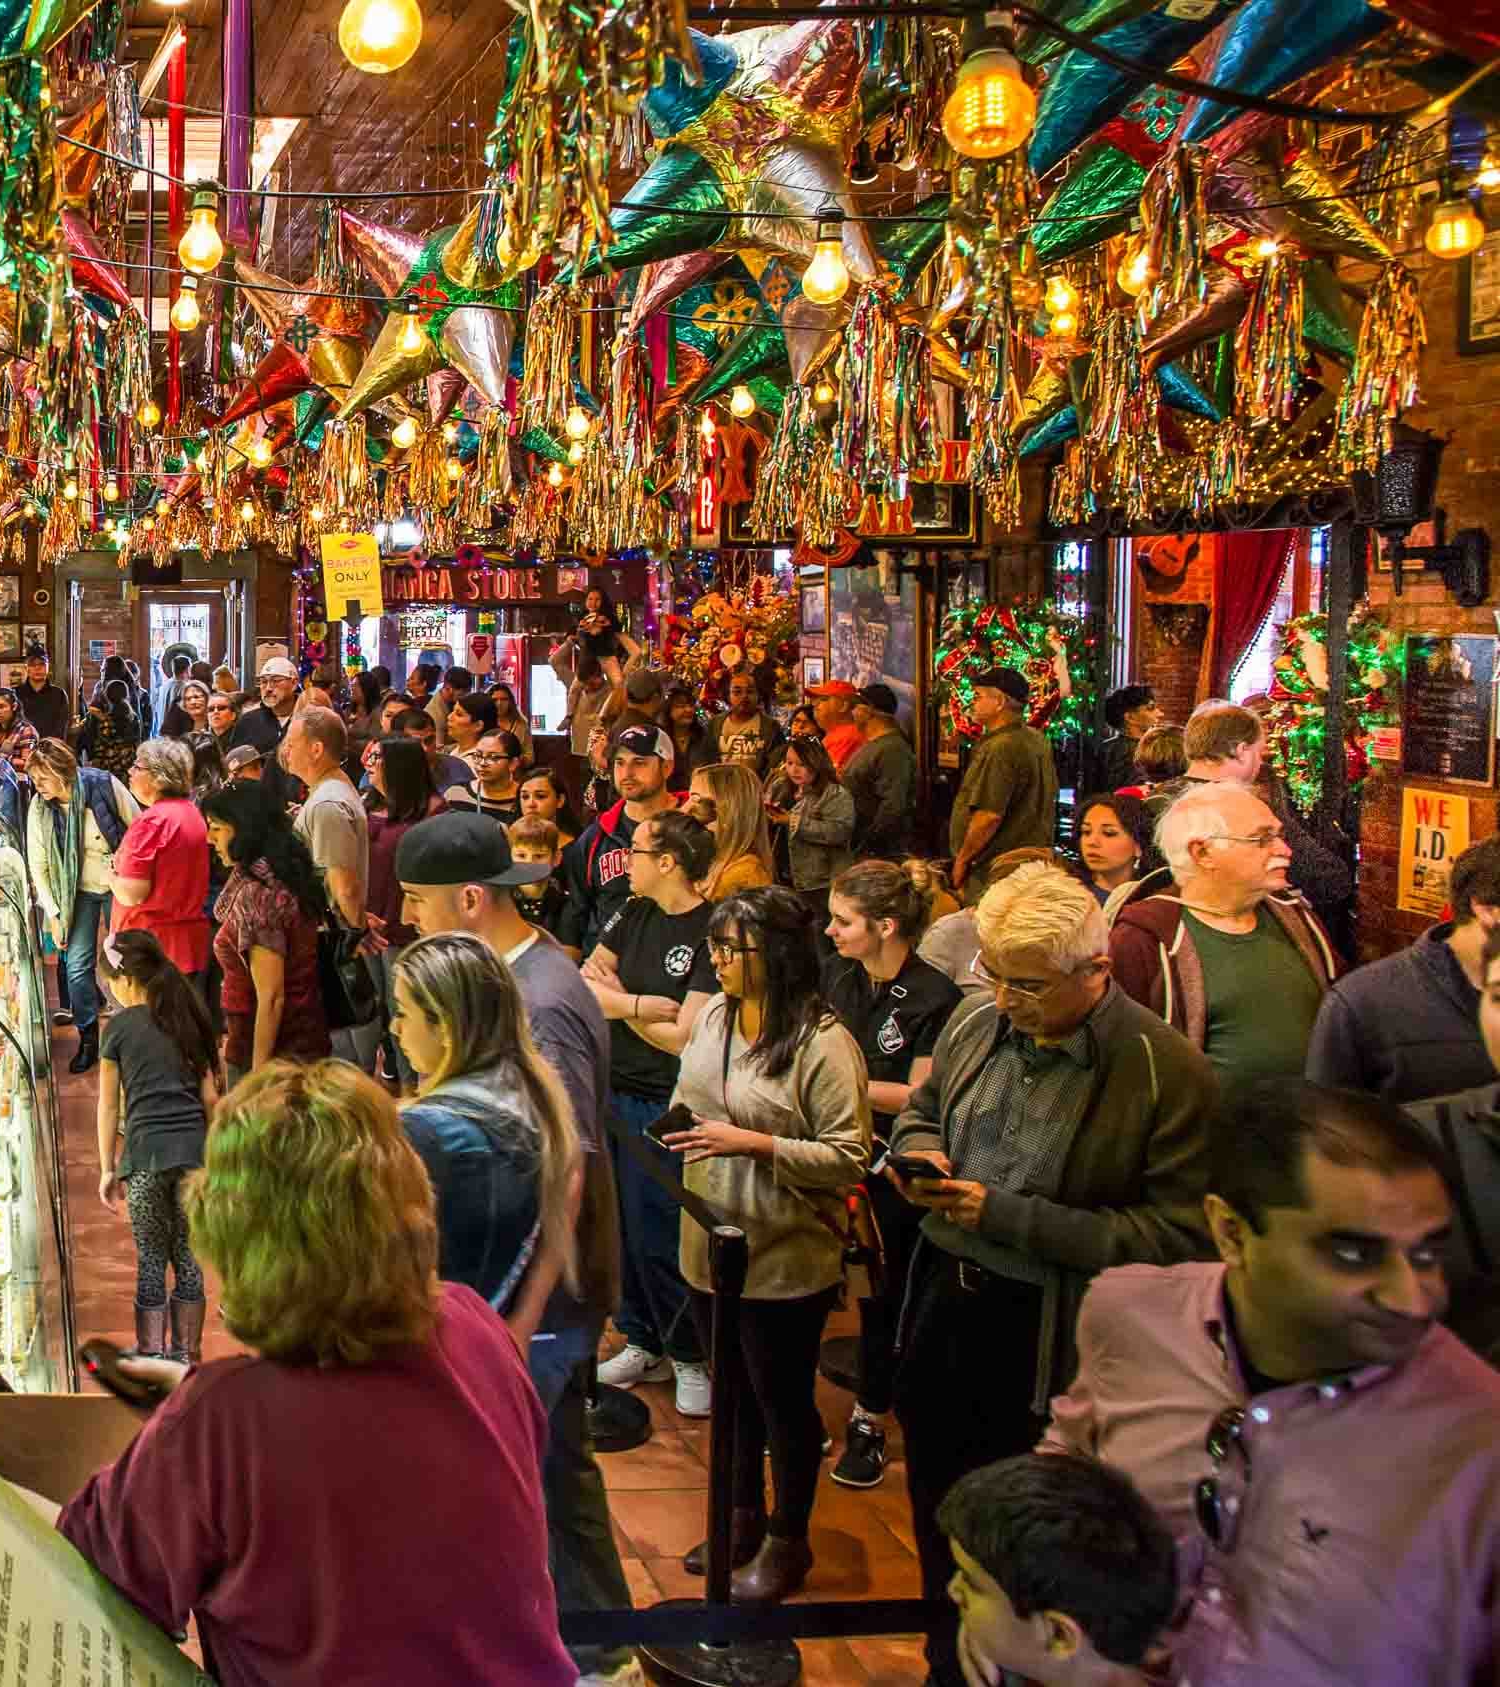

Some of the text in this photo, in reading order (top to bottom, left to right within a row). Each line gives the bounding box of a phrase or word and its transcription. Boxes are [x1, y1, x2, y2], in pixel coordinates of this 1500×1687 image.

[327, 557, 373, 569] BAKERY
[334, 569, 372, 583] ONLY
[467, 567, 542, 600] STORE
[404, 625, 444, 638] FIESTA
[1413, 796, 1453, 829] WE
